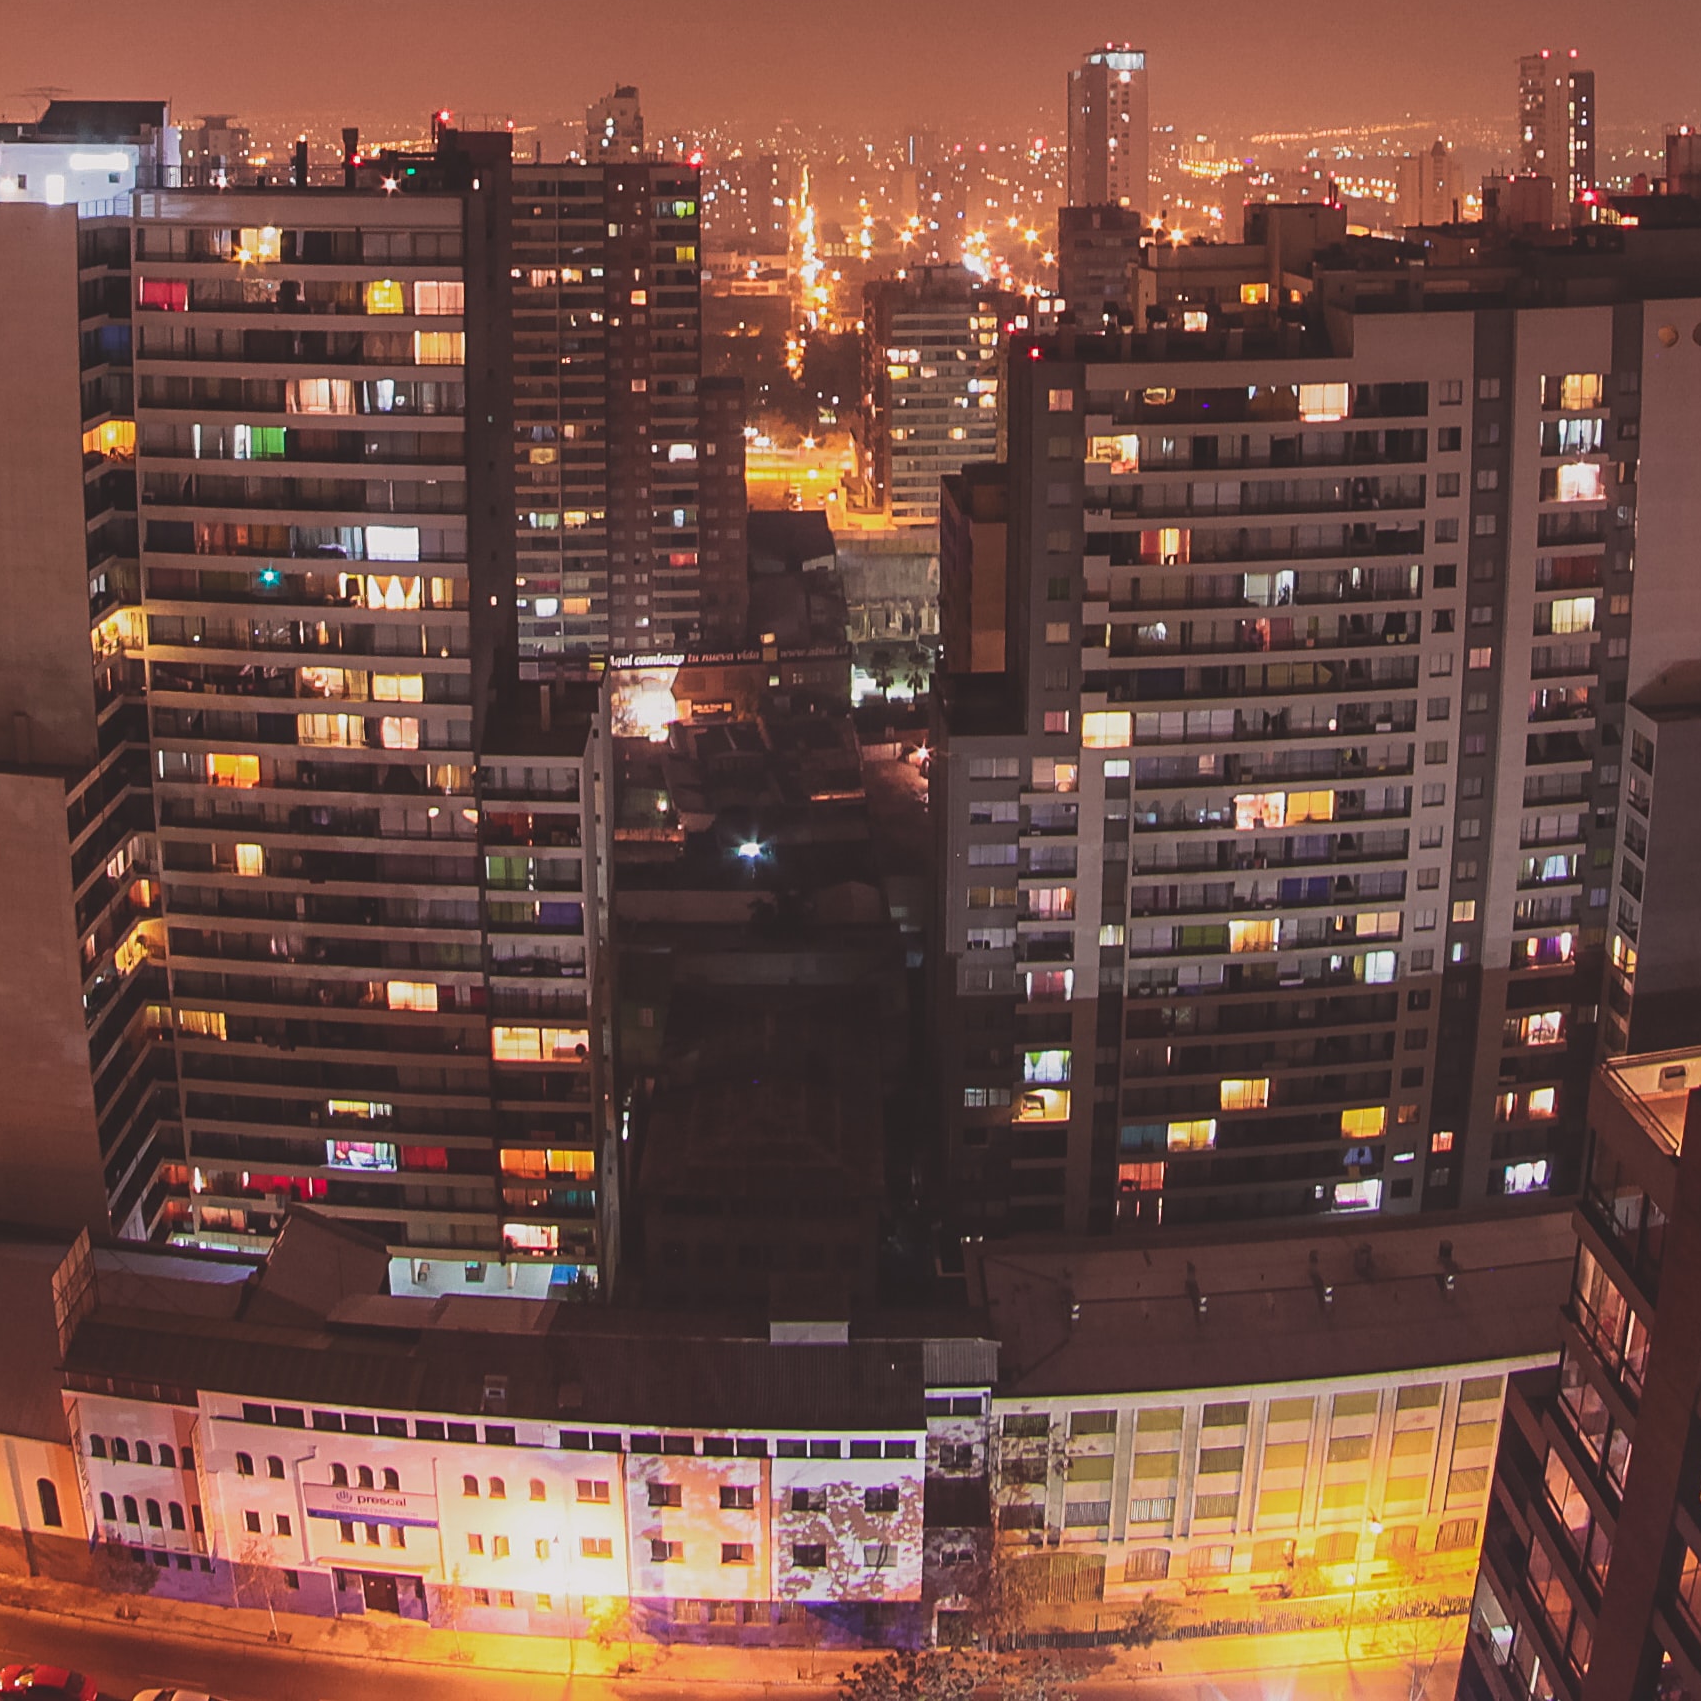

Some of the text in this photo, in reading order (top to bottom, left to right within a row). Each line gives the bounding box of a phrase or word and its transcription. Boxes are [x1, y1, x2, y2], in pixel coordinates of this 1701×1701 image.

[688, 653, 699, 663] tu
[702, 652, 734, 662] nueva
[737, 649, 760, 660] vida
[357, 1495, 407, 1507] prescal
